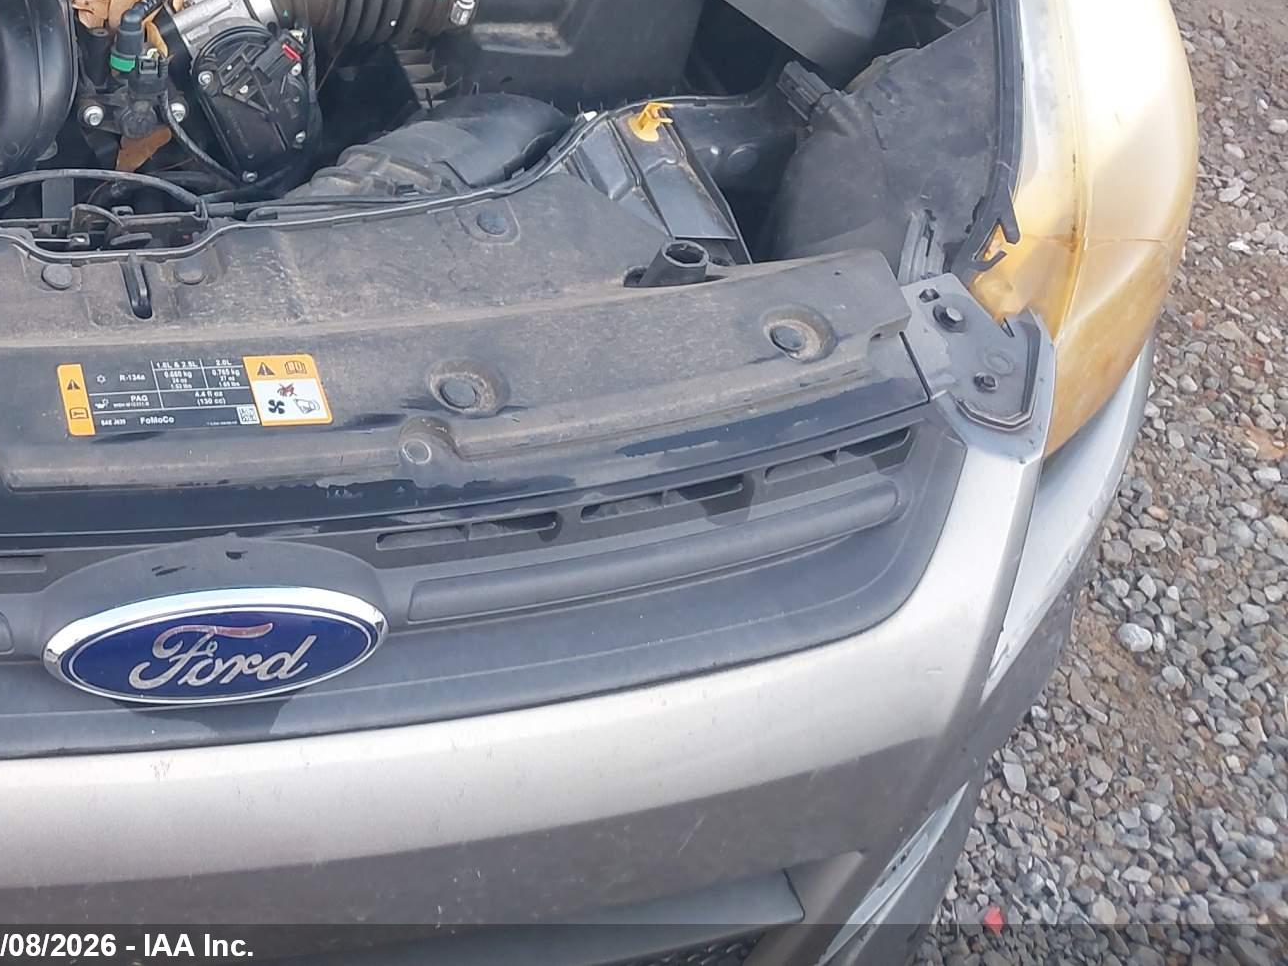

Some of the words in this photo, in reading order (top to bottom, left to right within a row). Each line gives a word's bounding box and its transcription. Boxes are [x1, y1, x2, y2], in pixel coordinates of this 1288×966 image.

[230, 369, 240, 377] kg
[140, 415, 174, 424] FoMoCo
[128, 622, 318, 690] Ford
